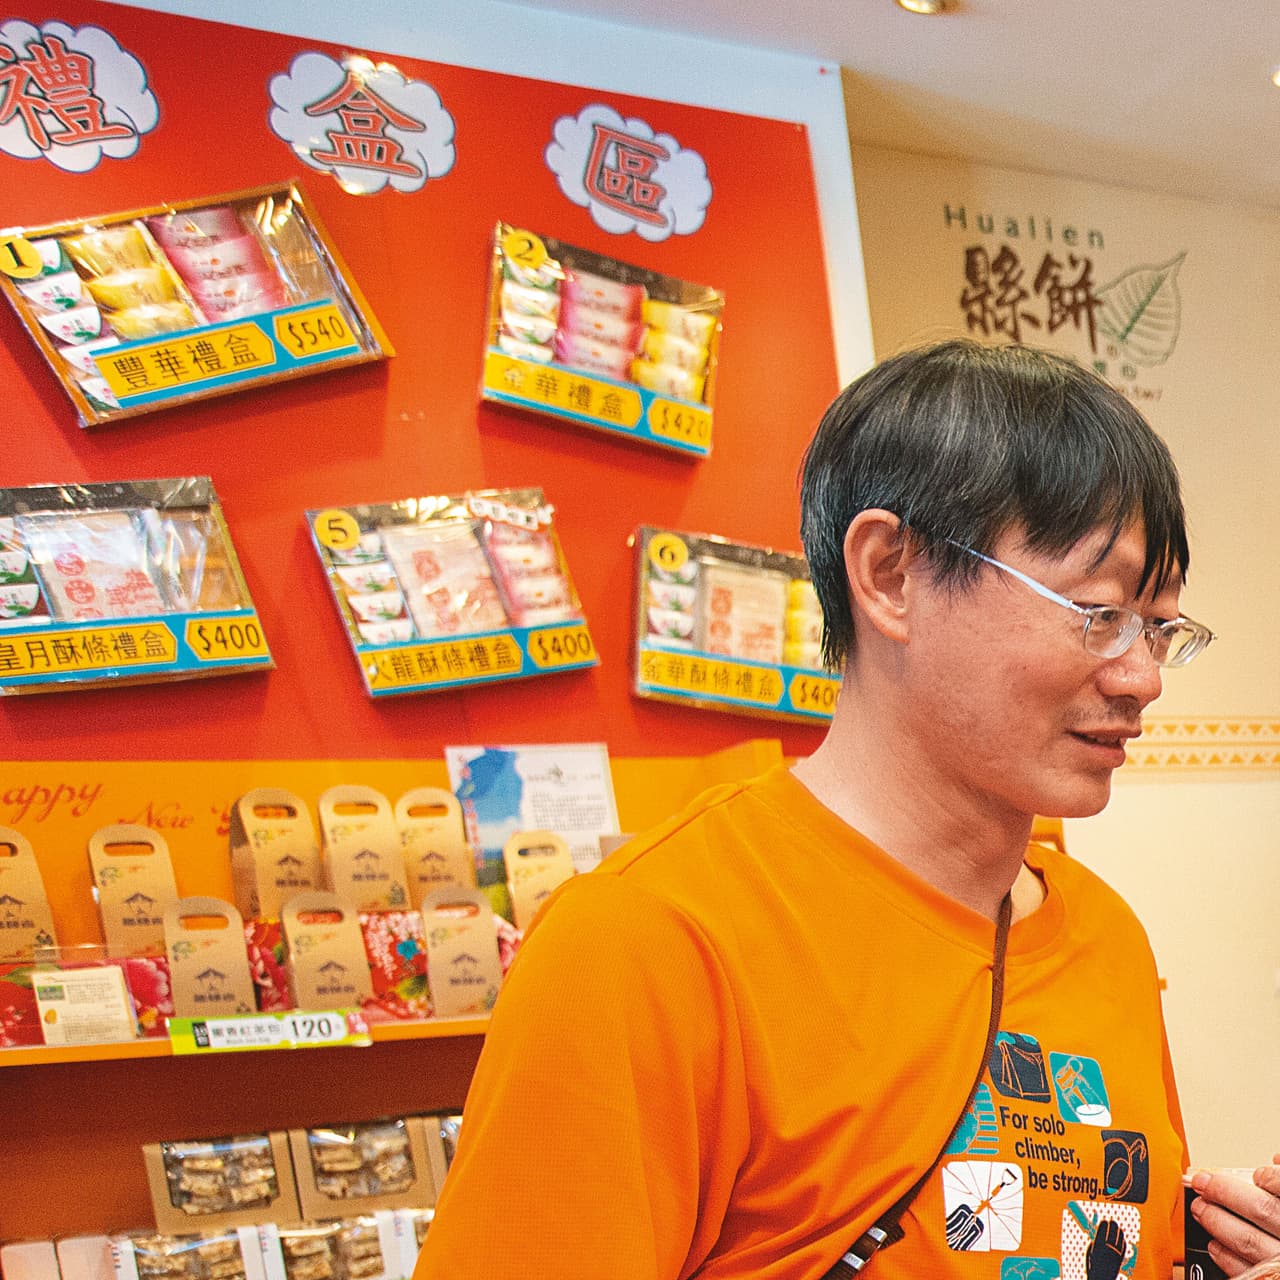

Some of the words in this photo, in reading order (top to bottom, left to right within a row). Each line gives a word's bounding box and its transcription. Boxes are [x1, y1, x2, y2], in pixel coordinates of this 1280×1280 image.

[0, 35, 672, 226] 禮盒區
[944, 203, 1105, 249] Hualien
[515, 237, 534, 262] 2
[960, 245, 1105, 355] 縣餅
[286, 314, 346, 351] $540
[112, 333, 261, 392] 豐華禮盒
[326, 518, 349, 544] 5
[196, 623, 261, 653] $400
[536, 632, 591, 661] $400
[800, 680, 842, 708] $40
[290, 1017, 333, 1039] 120
[999, 1105, 1029, 1130] For
[1032, 1114, 1065, 1136] solo
[1015, 1136, 1081, 1169] climber,
[1027, 1165, 1048, 1189] be
